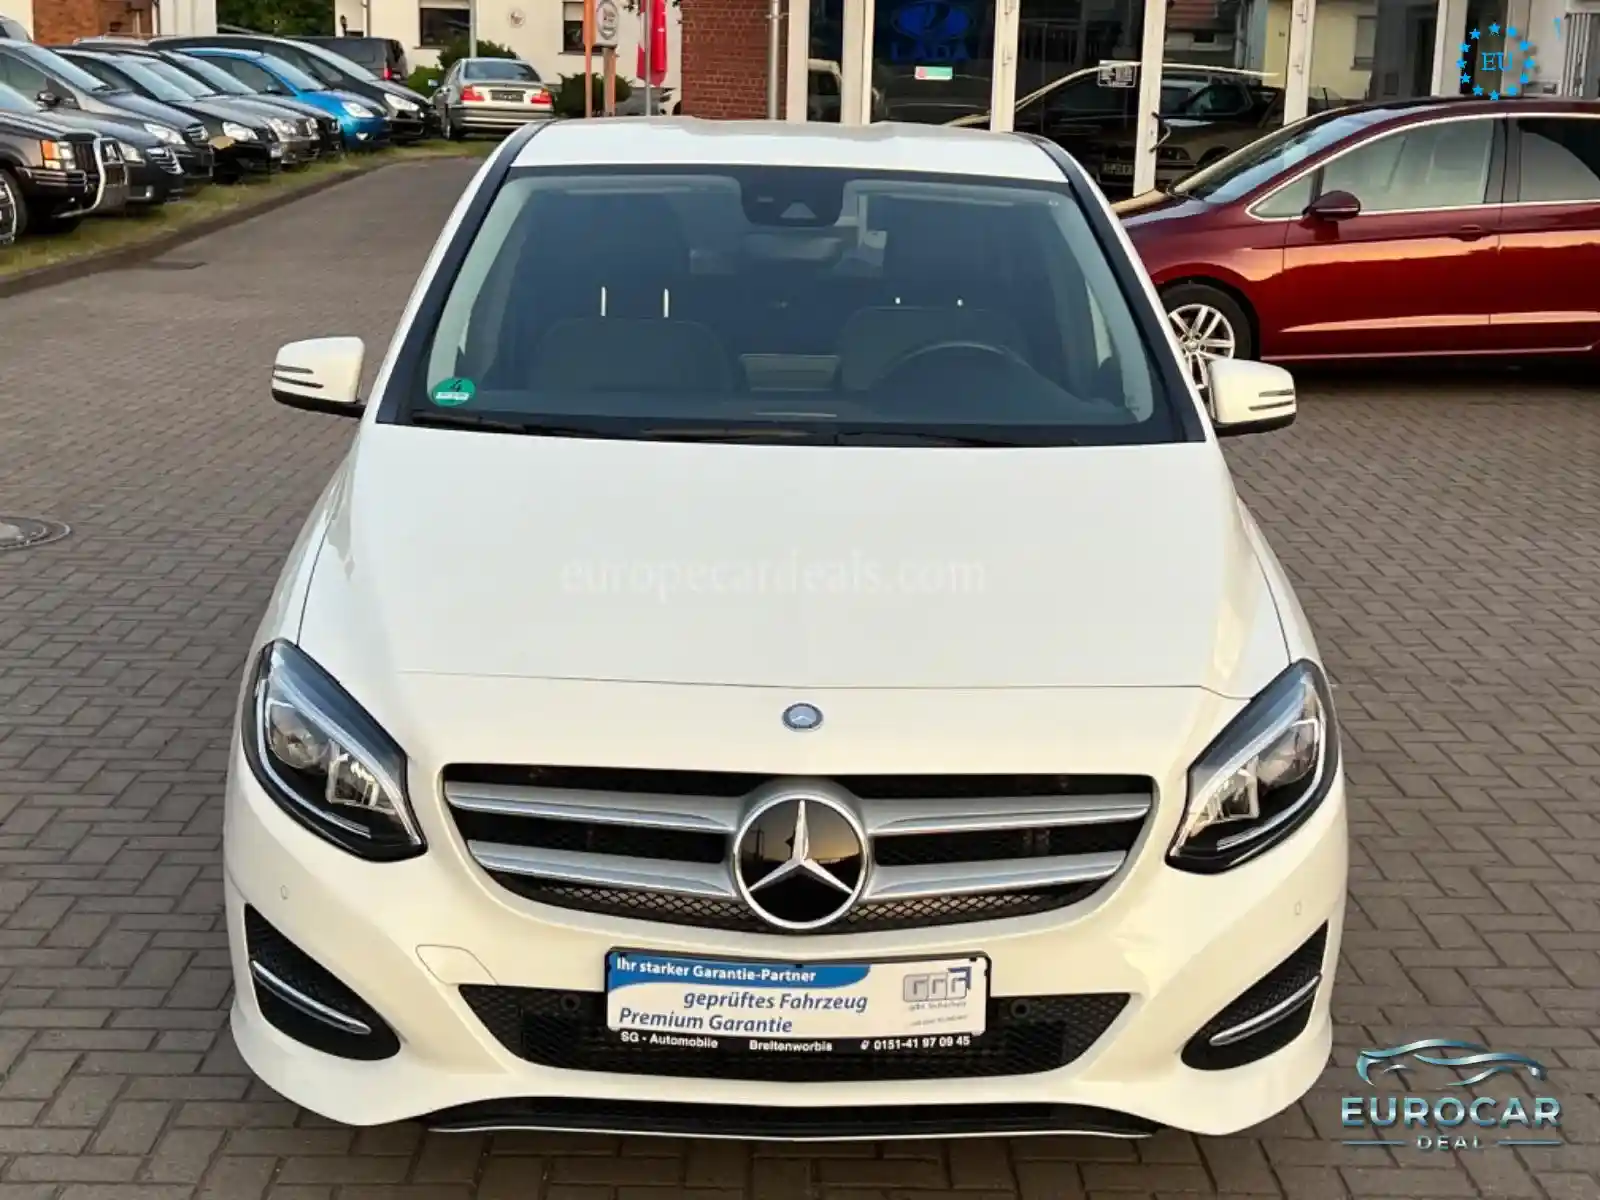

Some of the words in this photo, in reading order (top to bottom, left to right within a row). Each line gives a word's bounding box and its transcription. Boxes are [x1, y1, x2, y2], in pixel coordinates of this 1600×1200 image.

[891, 41, 972, 62] LADA
[616, 956, 636, 972] Ihr
[639, 961, 690, 977] starker
[692, 964, 817, 984] Garantie-Partner
[683, 991, 775, 1011] geprüftes
[779, 992, 869, 1014] Fahrzeug
[619, 1006, 704, 1030] Premium
[708, 1013, 793, 1034] Garantie
[620, 1030, 640, 1043] SG
[649, 1033, 719, 1050] Automobile
[749, 1038, 833, 1053] Breitenworbis
[939, 1036, 954, 1047] 09
[956, 1034, 971, 1047] 45
